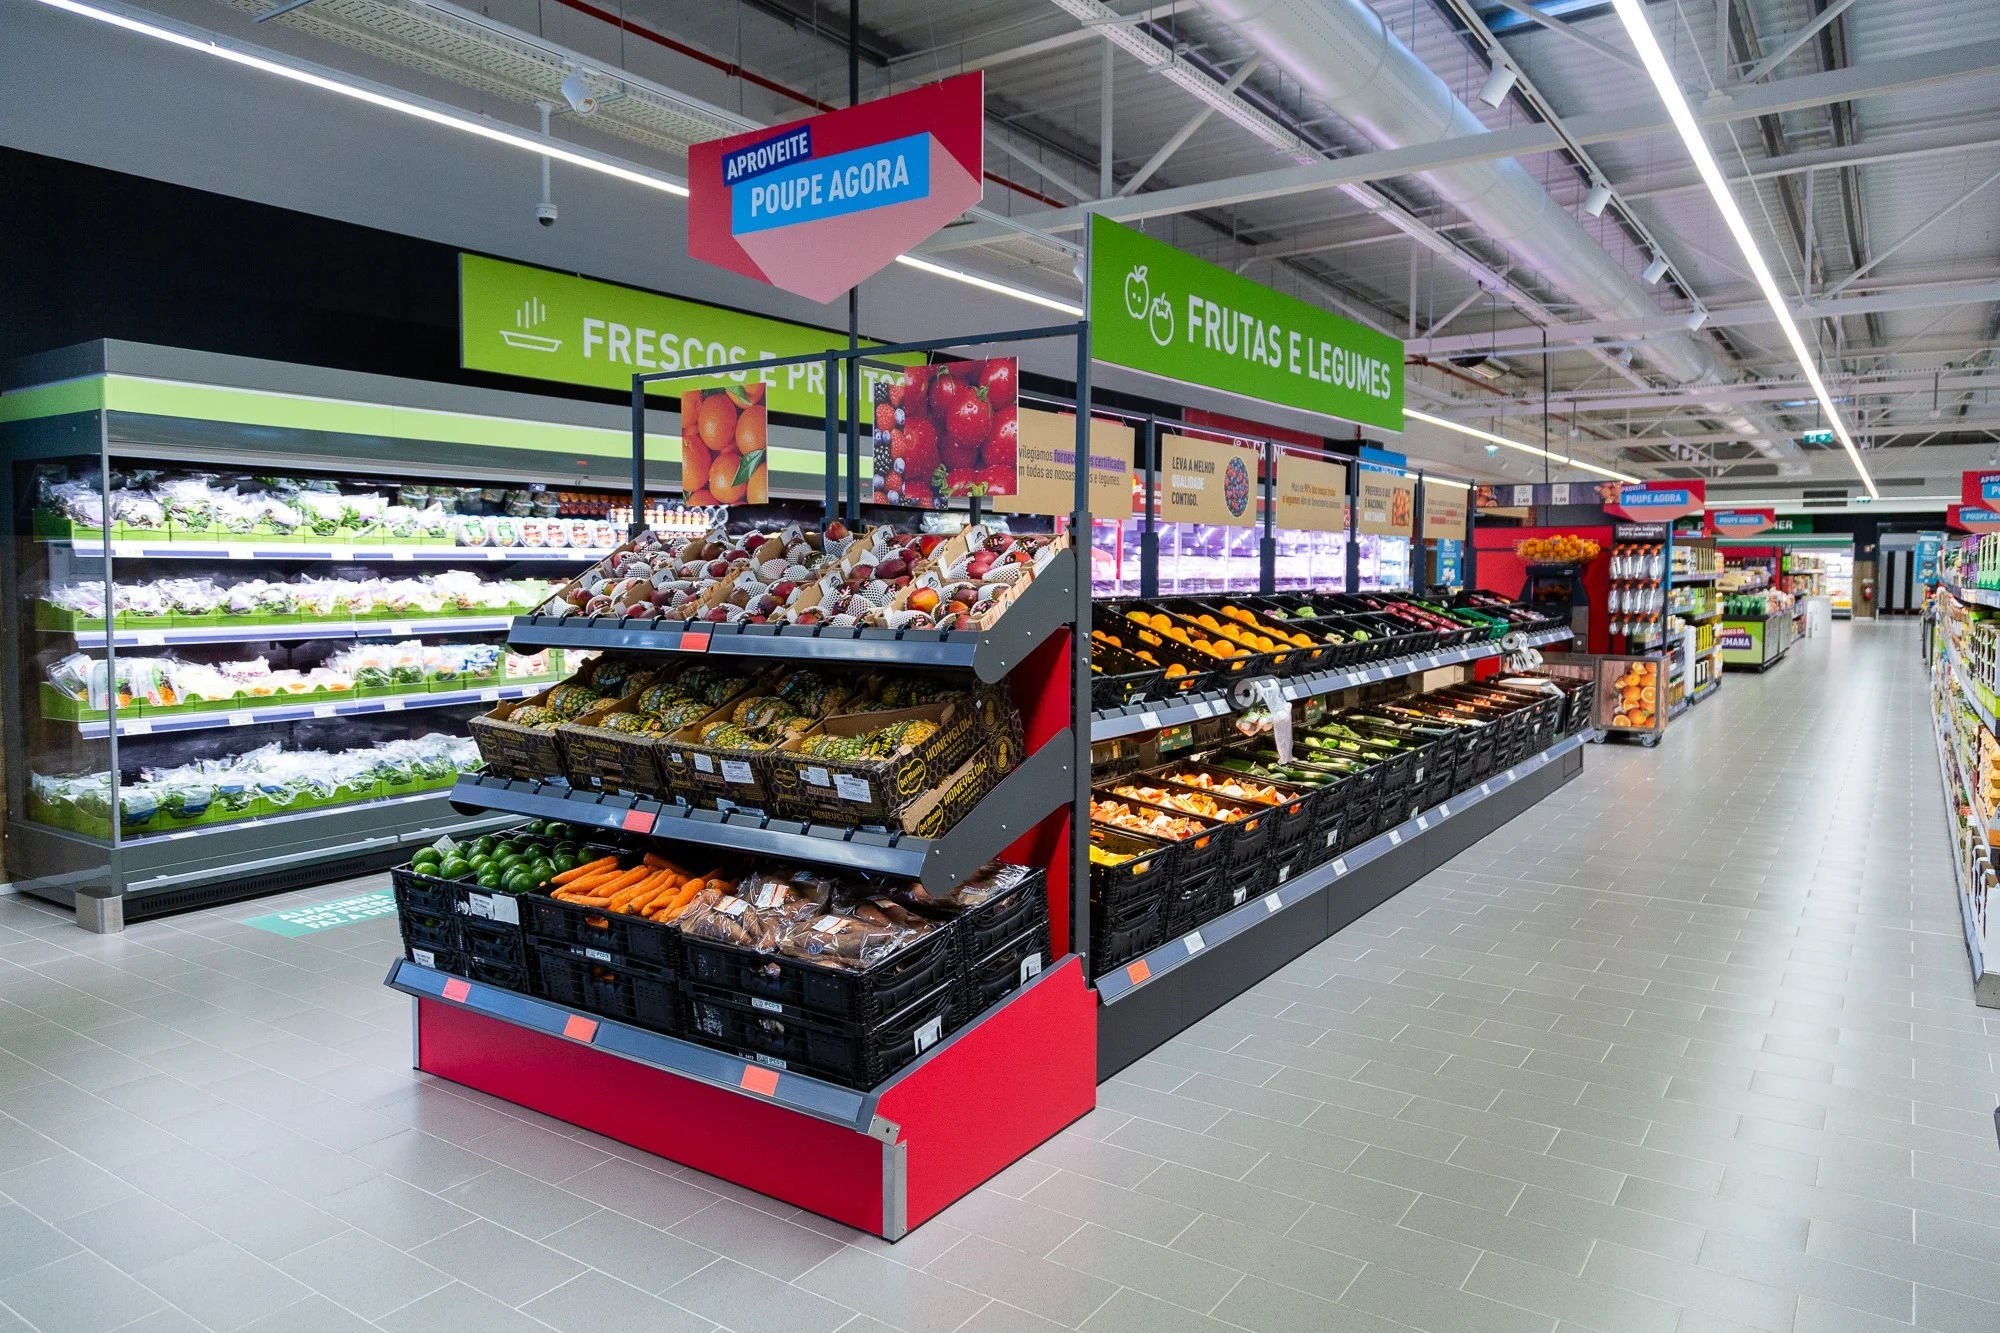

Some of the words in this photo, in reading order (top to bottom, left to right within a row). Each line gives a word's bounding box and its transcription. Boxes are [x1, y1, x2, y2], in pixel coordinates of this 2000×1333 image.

[726, 132, 809, 181] APROVEITE
[751, 173, 822, 218] POUPE
[828, 154, 910, 202] AGORA
[583, 317, 747, 383] FRESCOS
[760, 351, 777, 388] E
[1188, 294, 1282, 368] FRUTAS
[1289, 330, 1302, 375] E
[1308, 337, 1391, 400] LEGUMES
[1019, 445, 1053, 462] vilegiamos
[1054, 449, 1094, 467] fornecs
[1095, 456, 1126, 470] certificados
[1172, 456, 1188, 472] LEVA
[1188, 458, 1192, 472] A
[1194, 460, 1216, 474] MELHOR
[1026, 464, 1044, 478] todas
[1046, 469, 1053, 479] as
[1054, 469, 1075, 482] nossas
[1099, 474, 1120, 487] legumes.
[1172, 474, 1204, 490] QUALIDADE
[1622, 484, 1647, 492] PROVEITE
[1172, 492, 1198, 507] CONTIGO.
[1626, 494, 1652, 504] POUPE
[1654, 493, 1681, 502] AGORA
[1722, 638, 1750, 647] EMANA
[926, 714, 974, 762] HONEYGLOW
[908, 764, 925, 783] Monte
[944, 758, 988, 806] HONEYGLOW
[812, 810, 859, 824] HONEYGLOW
[927, 808, 942, 827] Monte
[338, 898, 394, 915] FRESC
[361, 904, 397, 916] DIF
